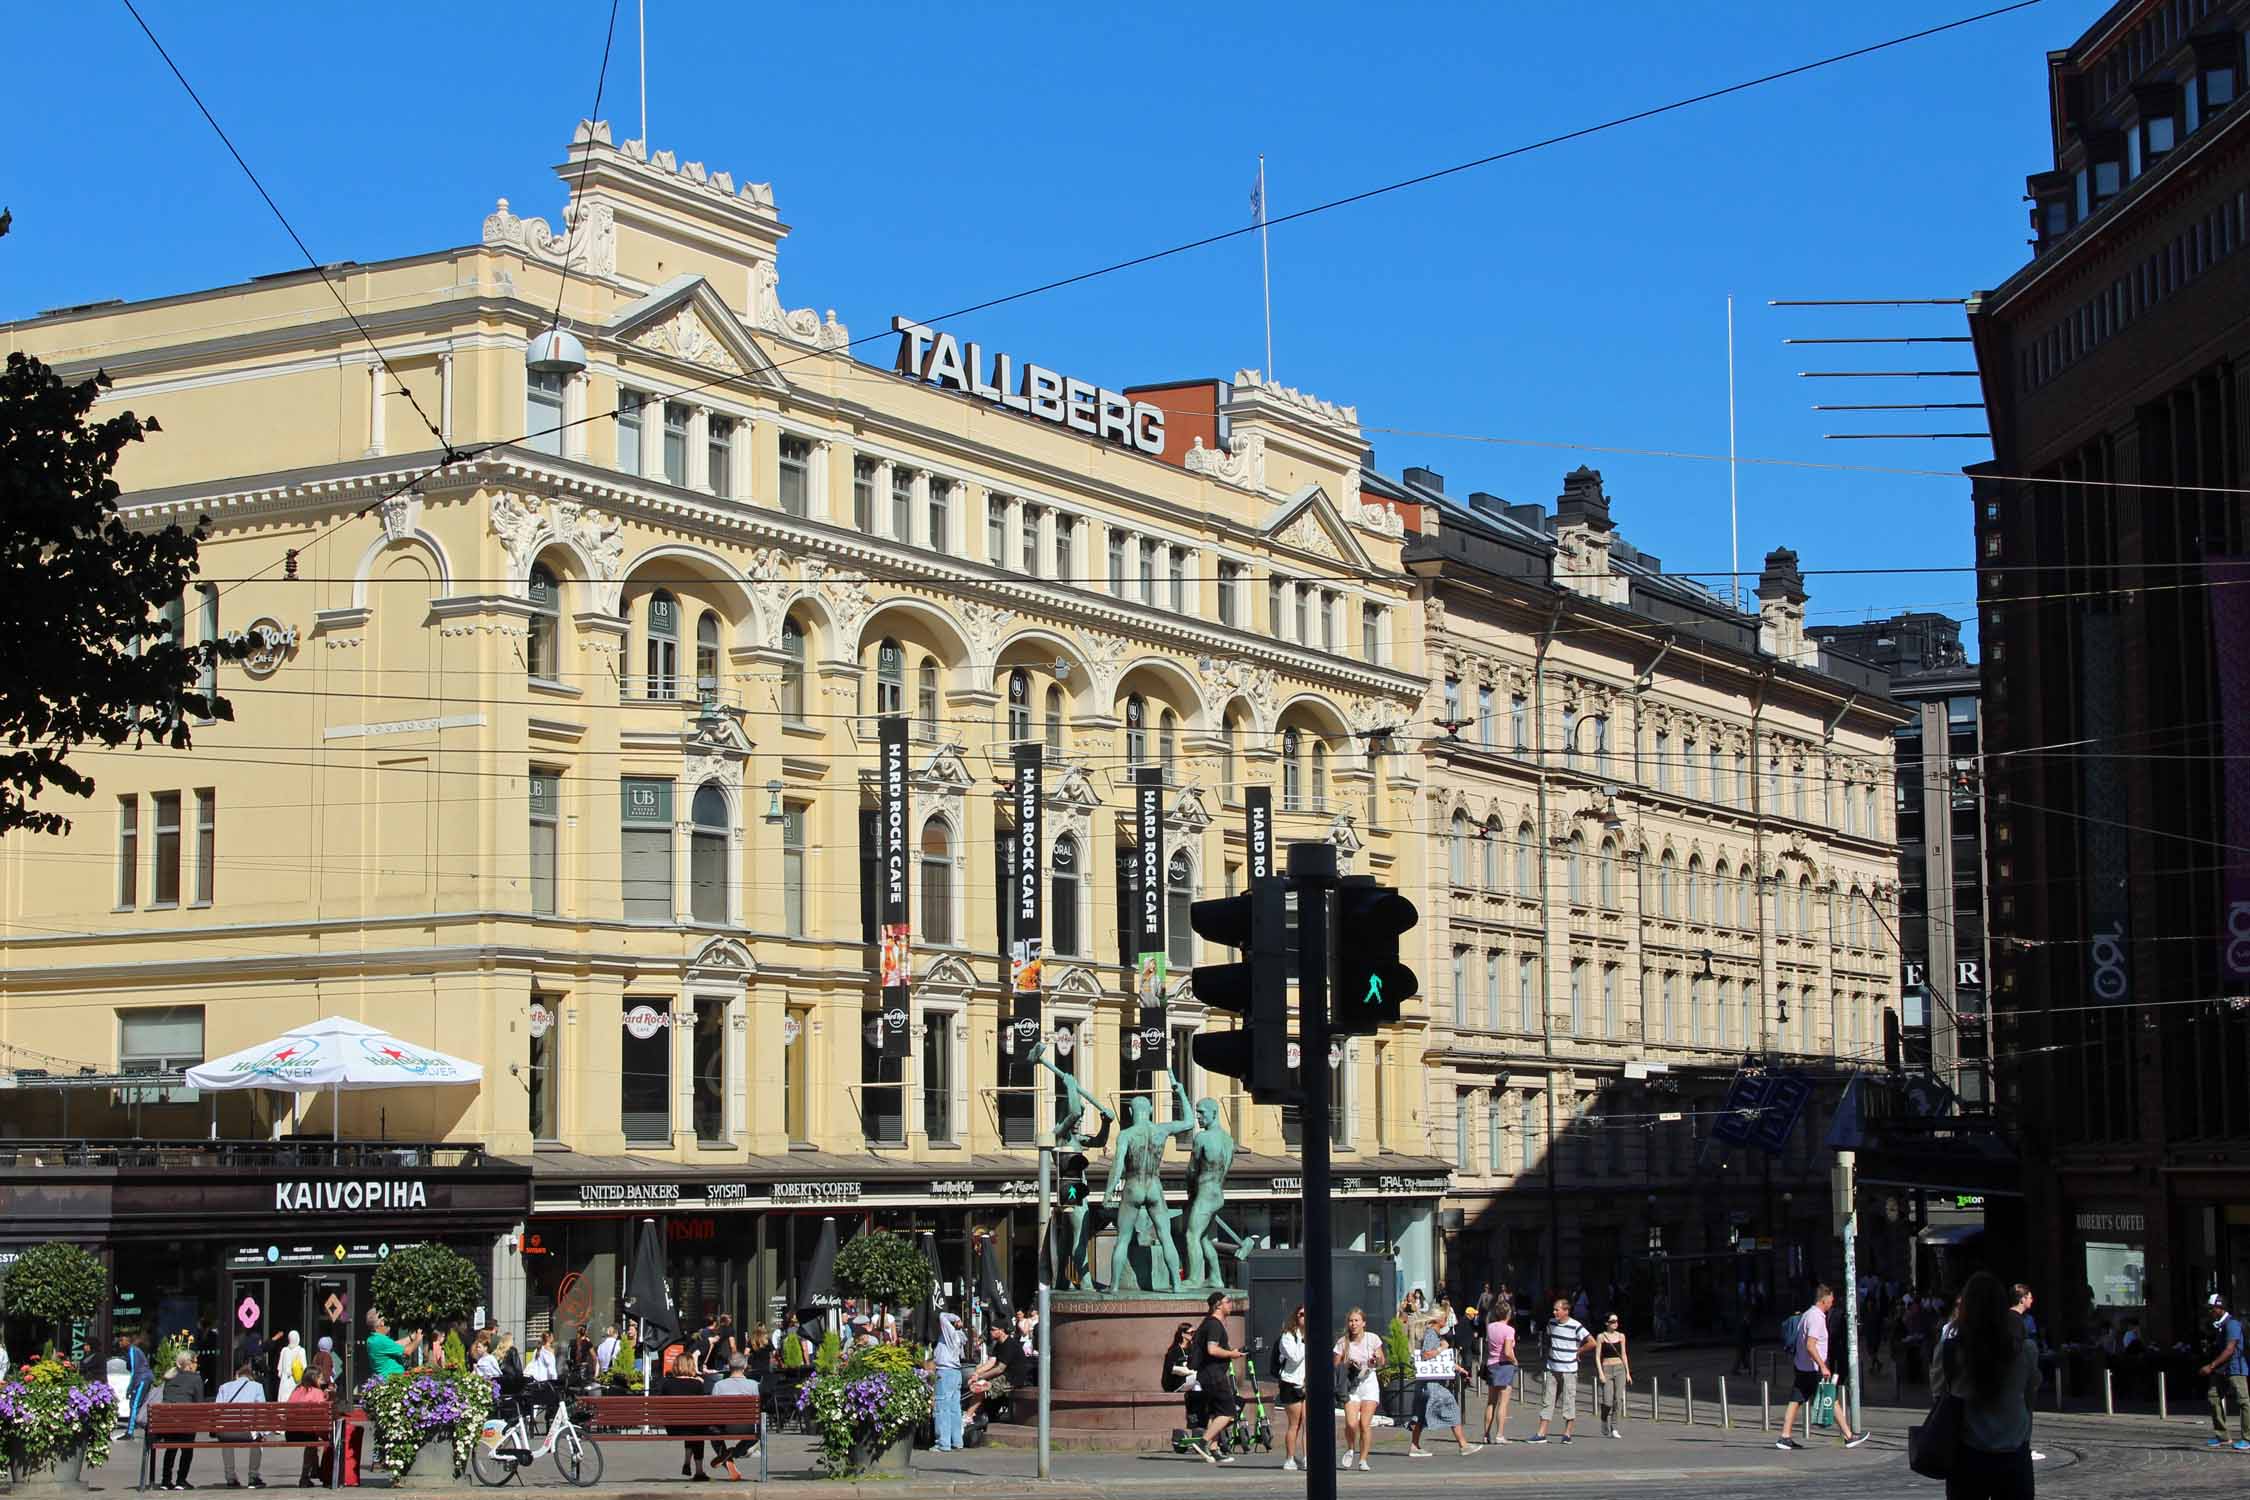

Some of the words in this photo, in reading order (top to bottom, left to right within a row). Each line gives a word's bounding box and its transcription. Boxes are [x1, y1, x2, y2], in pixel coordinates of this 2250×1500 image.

[892, 316, 1165, 455] TALLBERG
[654, 600, 668, 616] UB
[262, 623, 297, 650] Rock
[882, 648, 895, 662] UB
[889, 743, 901, 797] HARD
[632, 789, 655, 805] UB
[1022, 768, 1035, 818] HARD
[889, 800, 902, 856] ROCK
[1144, 790, 1156, 839] HARD
[1253, 807, 1266, 853] HARD
[1022, 821, 1035, 872] ROCK
[1054, 843, 1072, 857] ORAL
[1144, 842, 1157, 888] ROCK
[1168, 859, 1187, 873] ORAL
[889, 859, 902, 904] CAFE
[1022, 874, 1035, 919] CAFE
[1145, 890, 1157, 933] CAFE
[644, 1013, 669, 1026] Rock
[266, 1066, 313, 1079] SILVER
[275, 1181, 427, 1210] KAIVOPIHA
[580, 1185, 625, 1201] UNITED
[626, 1184, 680, 1200] BANKERS
[707, 1183, 747, 1199] SYNSAM
[773, 1183, 821, 1197] ROBERT'S
[822, 1182, 861, 1196] COFFEE
[1379, 1175, 1403, 1188] ORAL
